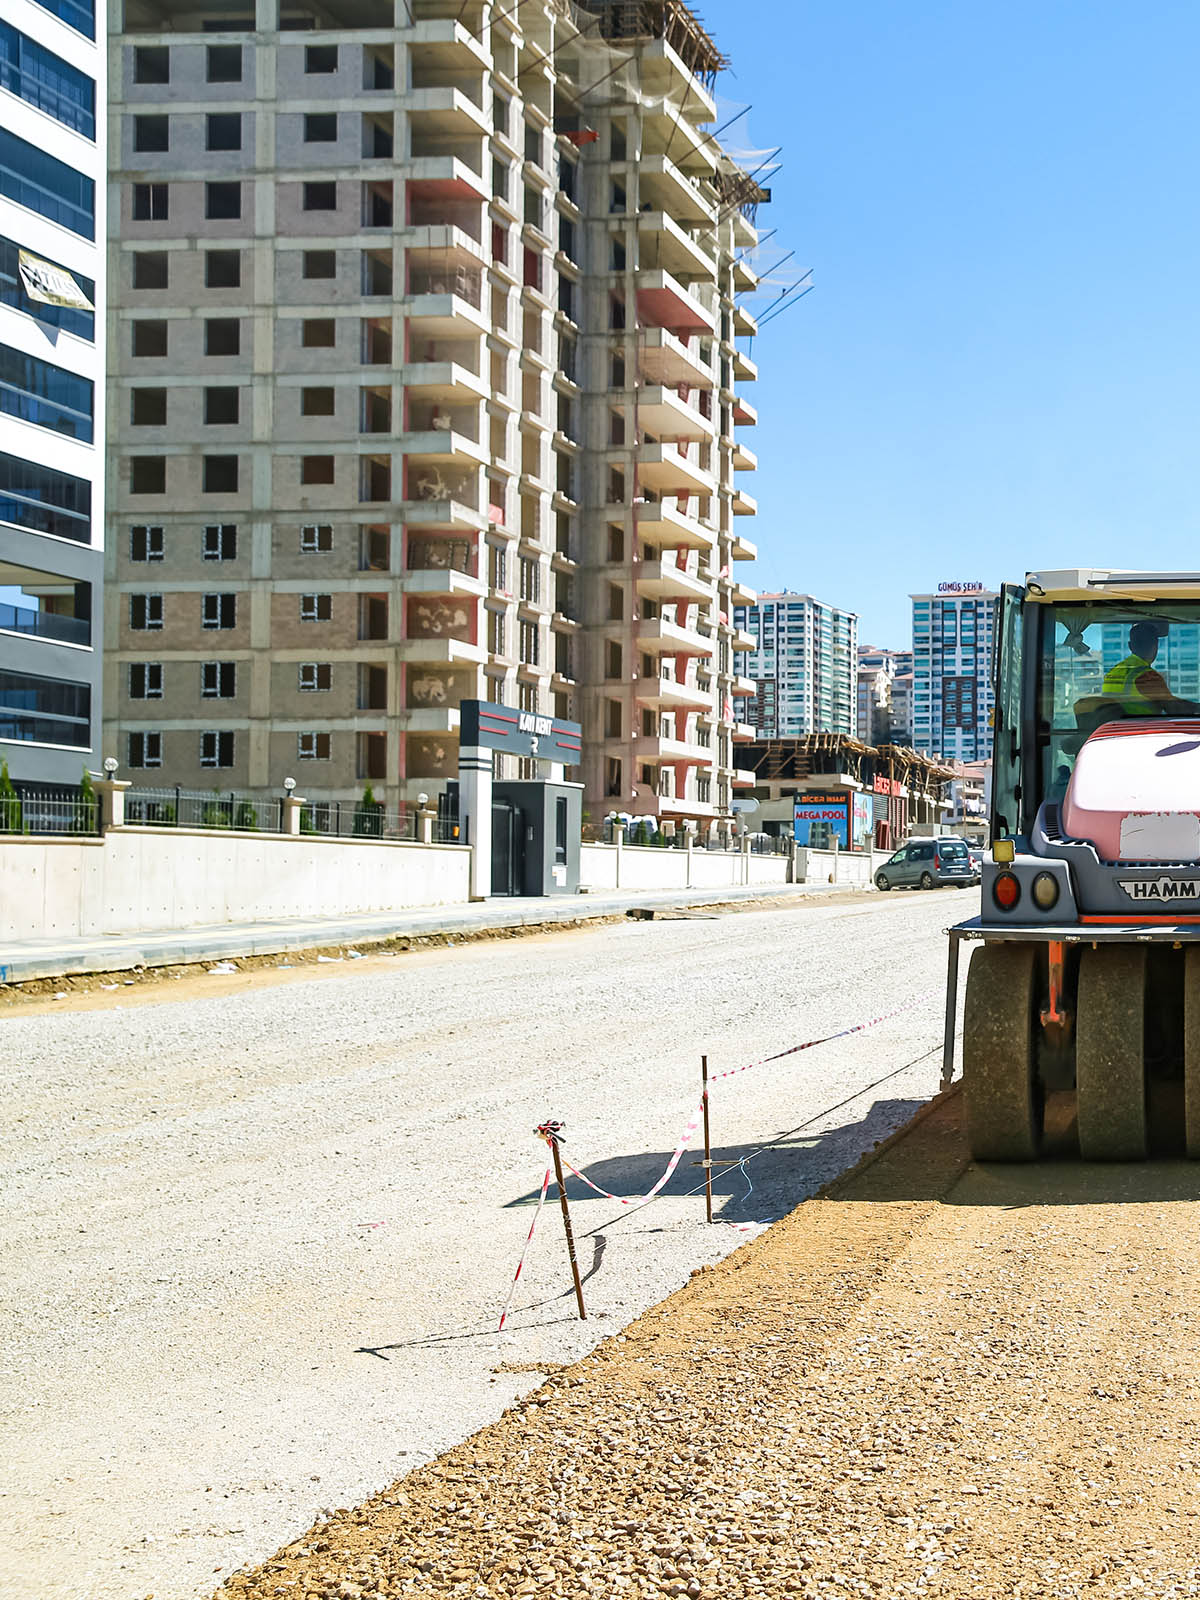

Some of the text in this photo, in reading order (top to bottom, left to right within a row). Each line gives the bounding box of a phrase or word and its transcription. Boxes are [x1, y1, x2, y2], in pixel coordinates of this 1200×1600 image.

[796, 811, 820, 820] MEGA
[822, 811, 846, 820] POOL
[1134, 882, 1196, 898] HAMM
